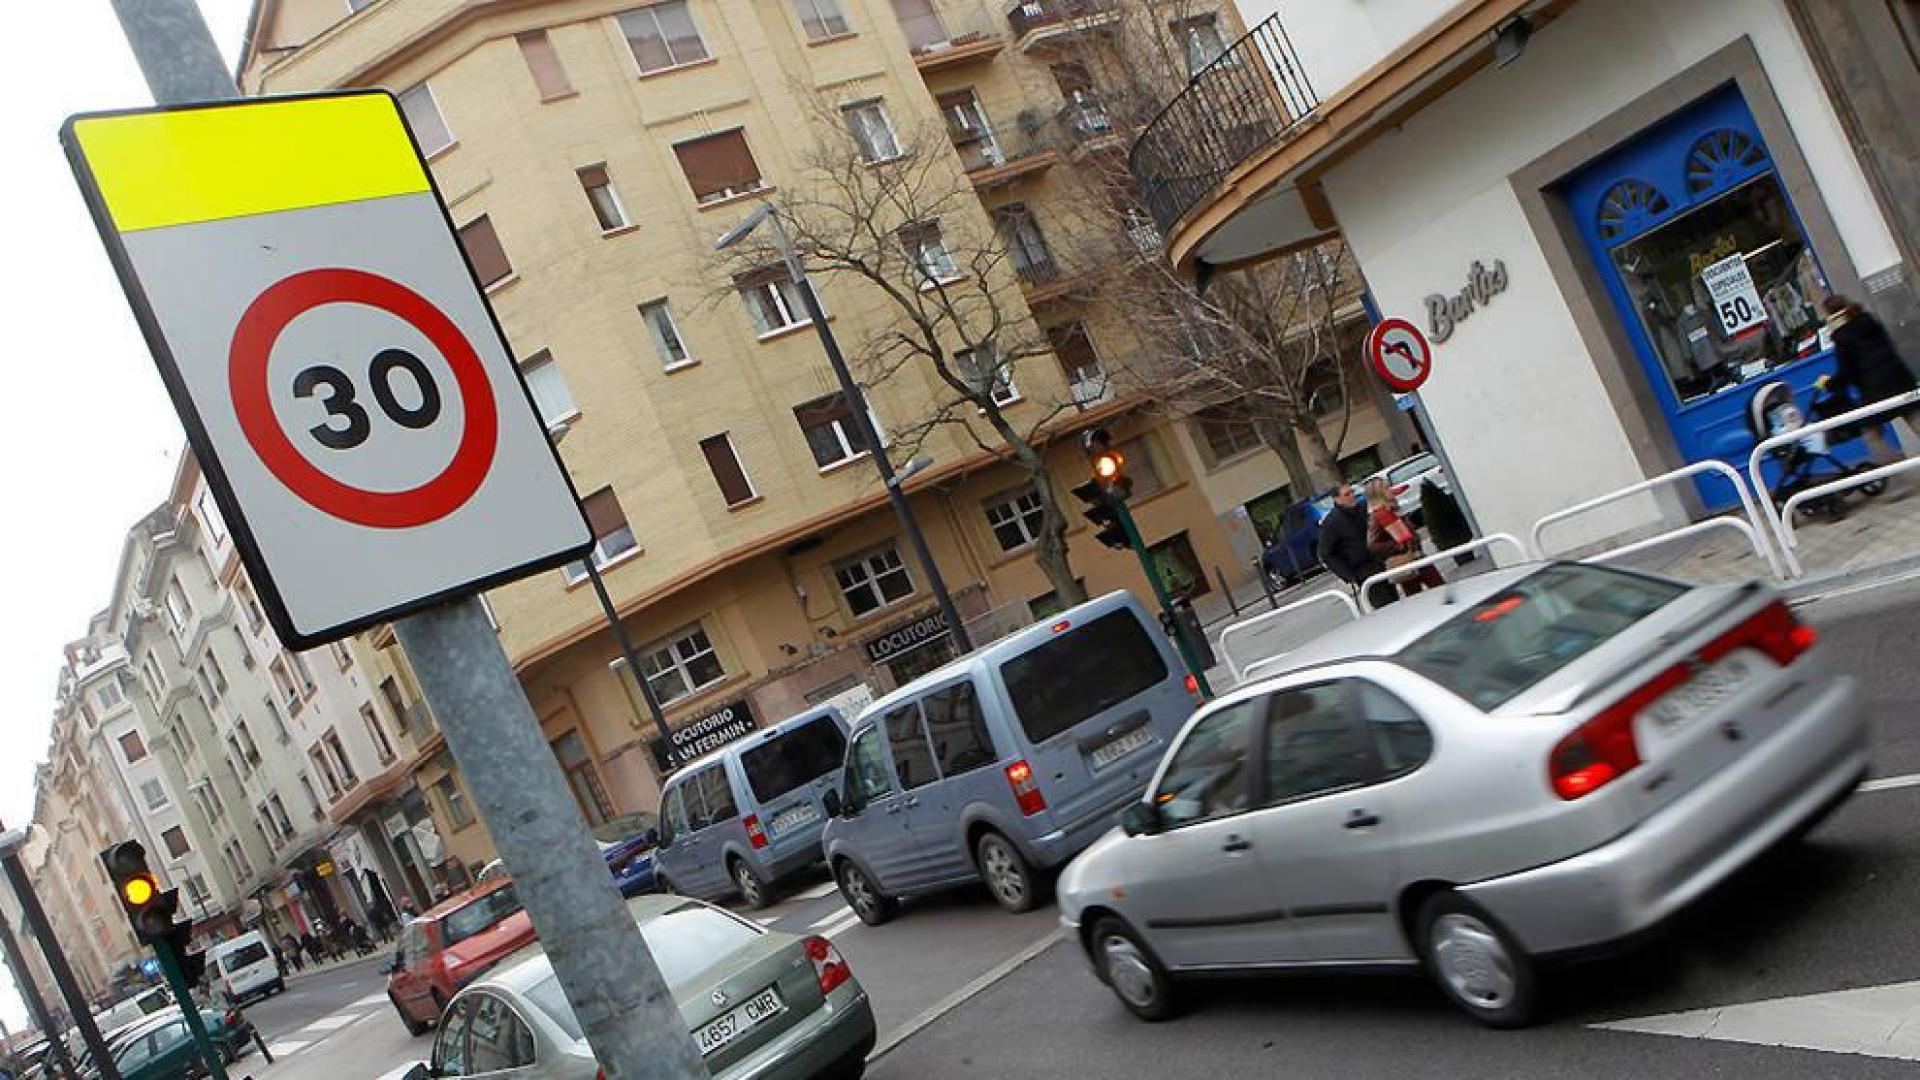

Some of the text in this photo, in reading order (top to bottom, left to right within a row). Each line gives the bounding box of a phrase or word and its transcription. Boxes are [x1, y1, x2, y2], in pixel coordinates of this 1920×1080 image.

[293, 348, 441, 449] 30
[672, 708, 734, 746] OCUTORIO
[701, 992, 777, 1048] 4657 CMR
